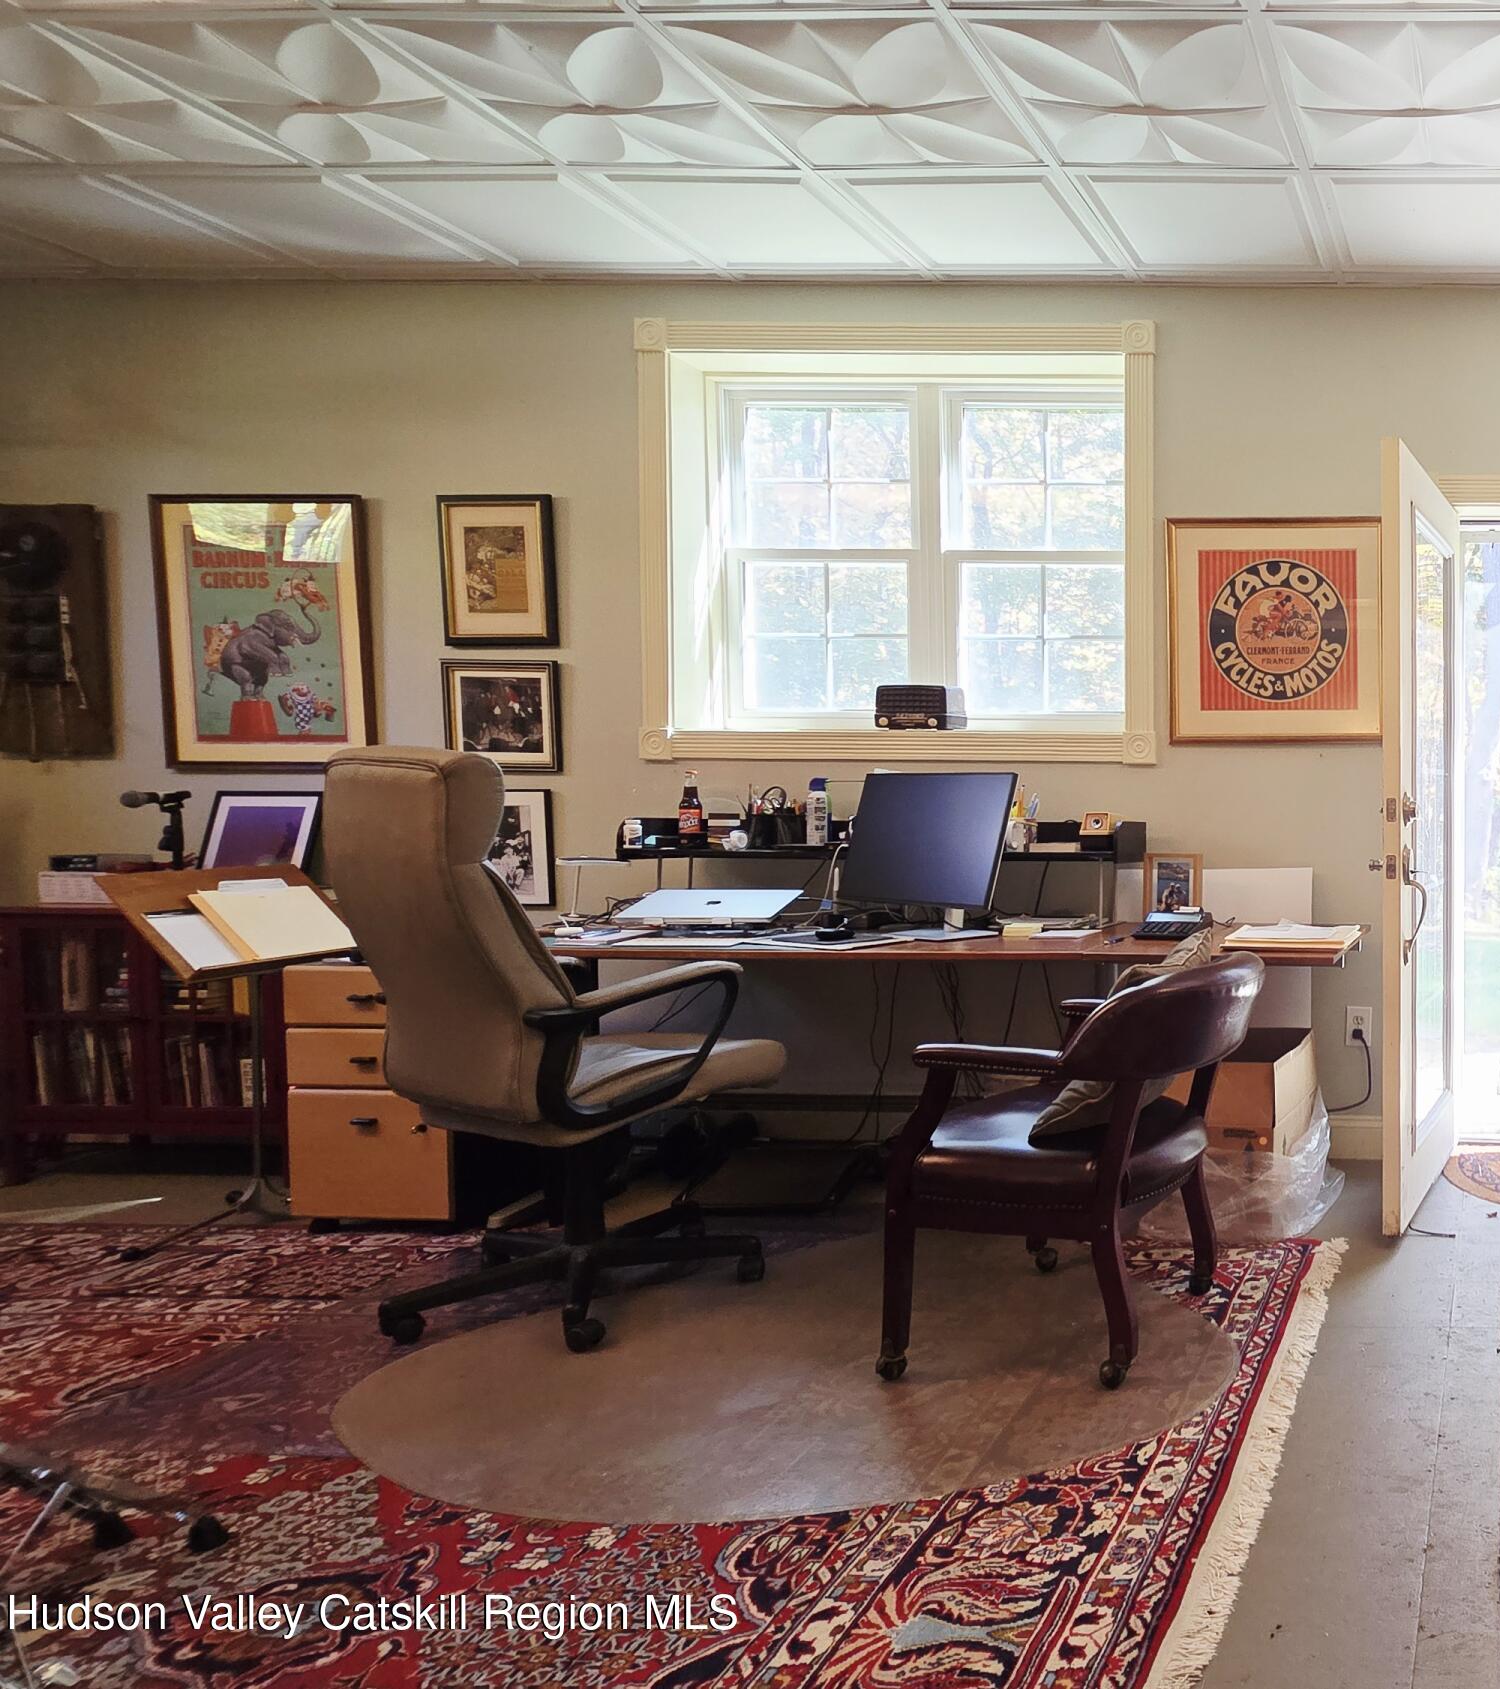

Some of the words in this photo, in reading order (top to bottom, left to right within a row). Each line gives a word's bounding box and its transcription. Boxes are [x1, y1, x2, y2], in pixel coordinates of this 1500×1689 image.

[192, 550, 266, 568] BARNUM
[200, 571, 271, 589] CIRCUS
[1216, 562, 1338, 618] FAVOR
[1246, 645, 1310, 656] CLERMONT-FERRAND
[1214, 641, 1275, 697] CYCLES
[1275, 681, 1285, 692] &
[1285, 639, 1344, 697] MOTOS
